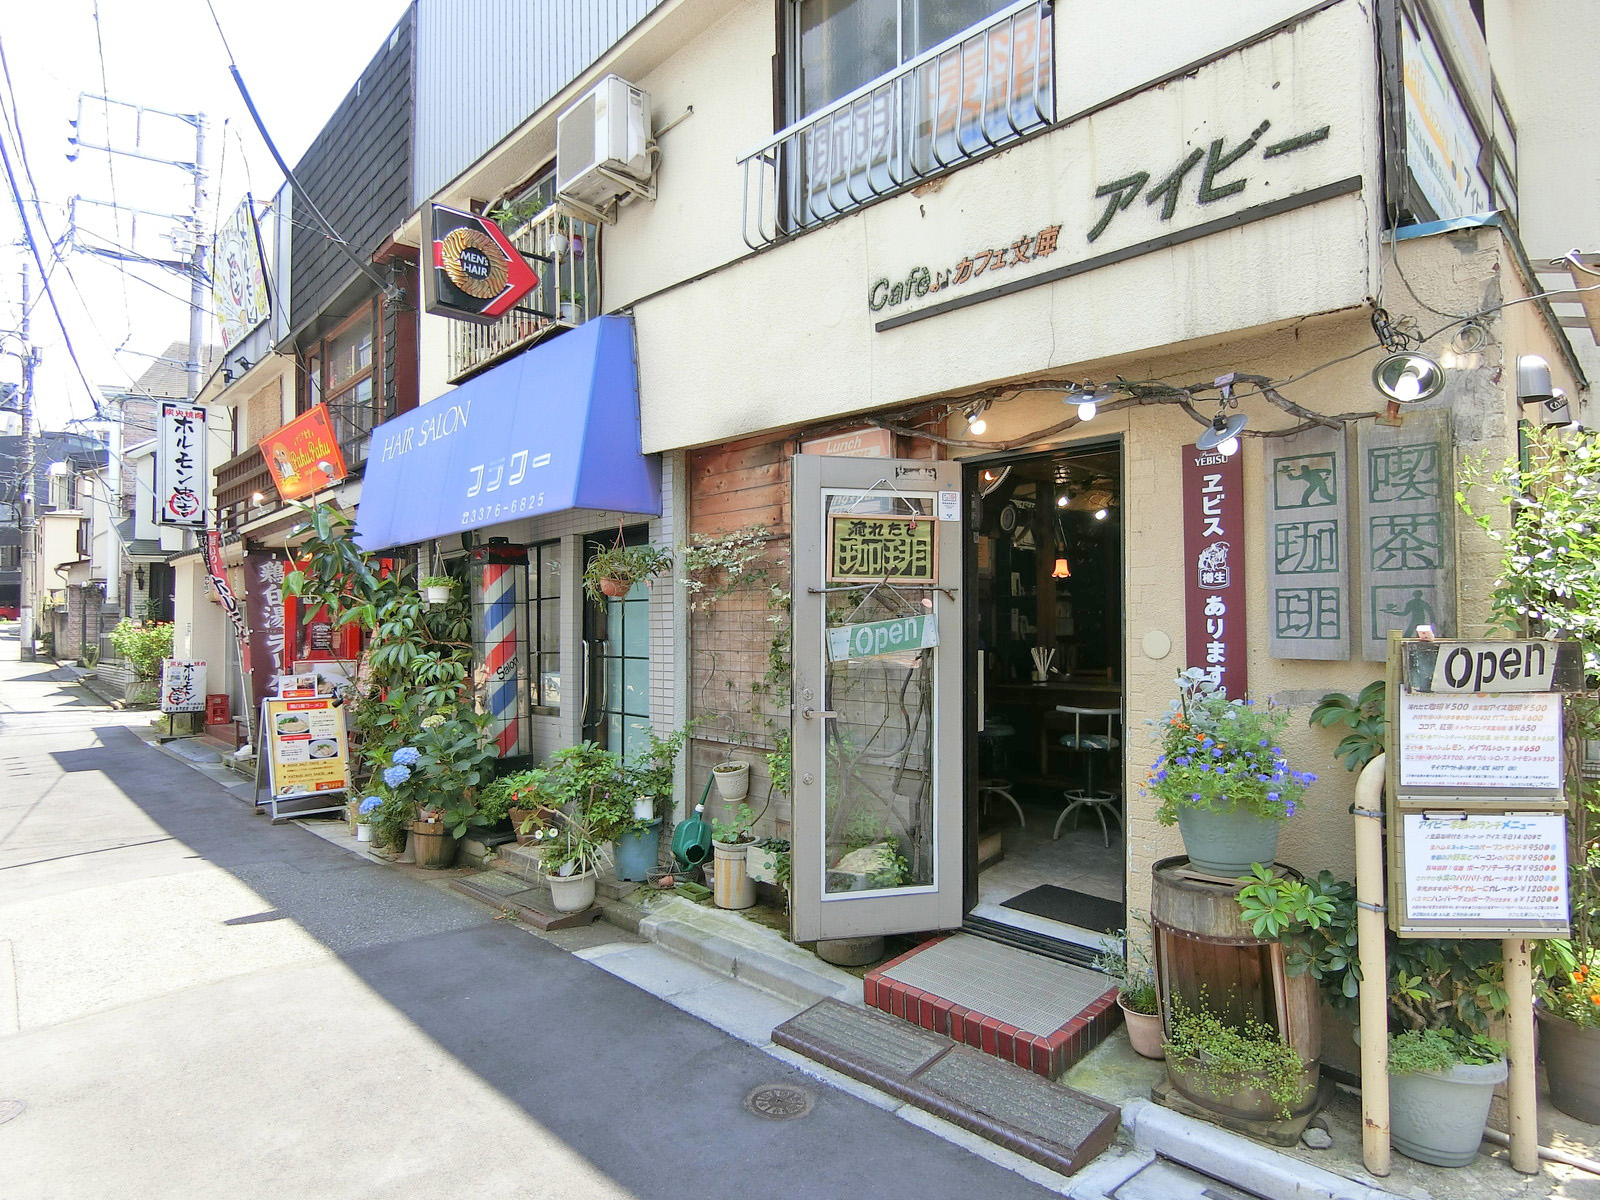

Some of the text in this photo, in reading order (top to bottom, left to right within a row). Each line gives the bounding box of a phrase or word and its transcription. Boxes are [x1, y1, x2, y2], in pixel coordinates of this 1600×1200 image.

[1087, 119, 1330, 242] アイビー
[463, 262, 488, 277] HAIR
[952, 225, 1062, 285] カフェ文庫
[165, 408, 204, 419] 炭火焼肉
[382, 400, 471, 463] HAIR SALON
[826, 436, 862, 454] Lunch
[1195, 455, 1228, 466] YEBISU
[1369, 443, 1444, 571] 喫茶
[839, 538, 927, 576] 珈琲
[1275, 520, 1340, 640] 珈琲
[855, 616, 919, 655] Open
[496, 657, 519, 680] Salon
[1444, 643, 1546, 692] Open
